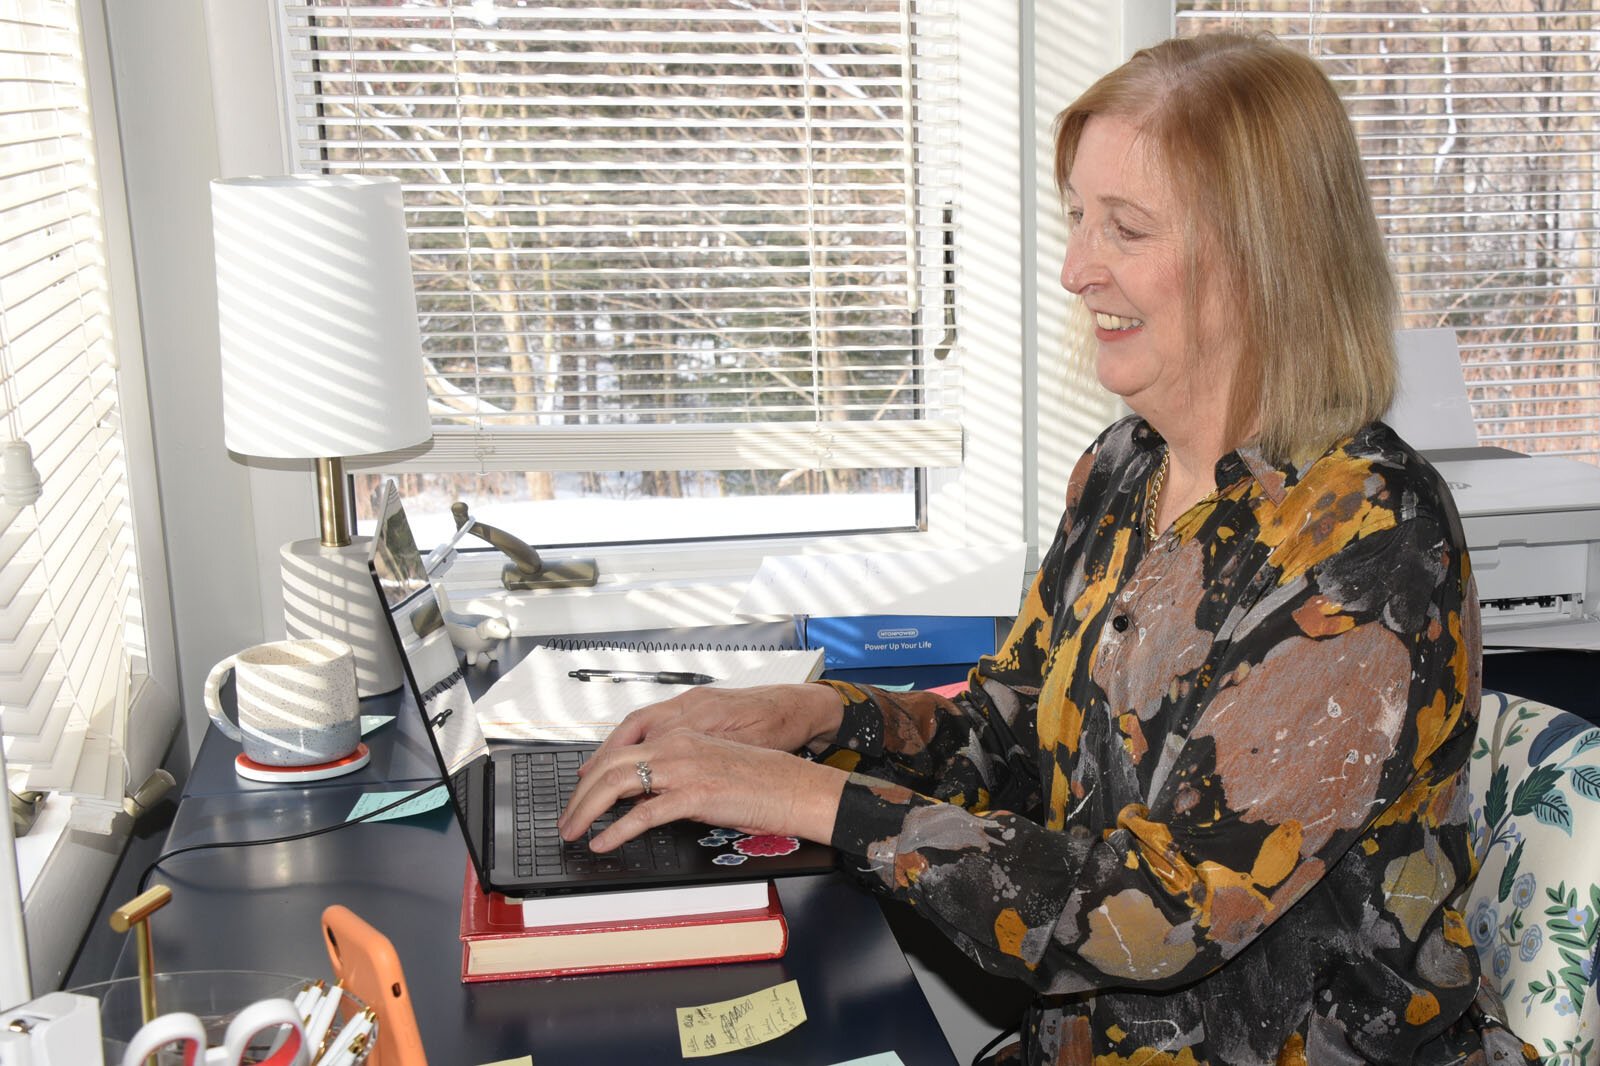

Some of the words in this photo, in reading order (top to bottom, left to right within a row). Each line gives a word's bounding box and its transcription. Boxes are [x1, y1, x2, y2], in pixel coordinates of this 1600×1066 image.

[864, 643, 887, 651] Power
[889, 643, 900, 651] Up
[918, 641, 932, 649] Life
